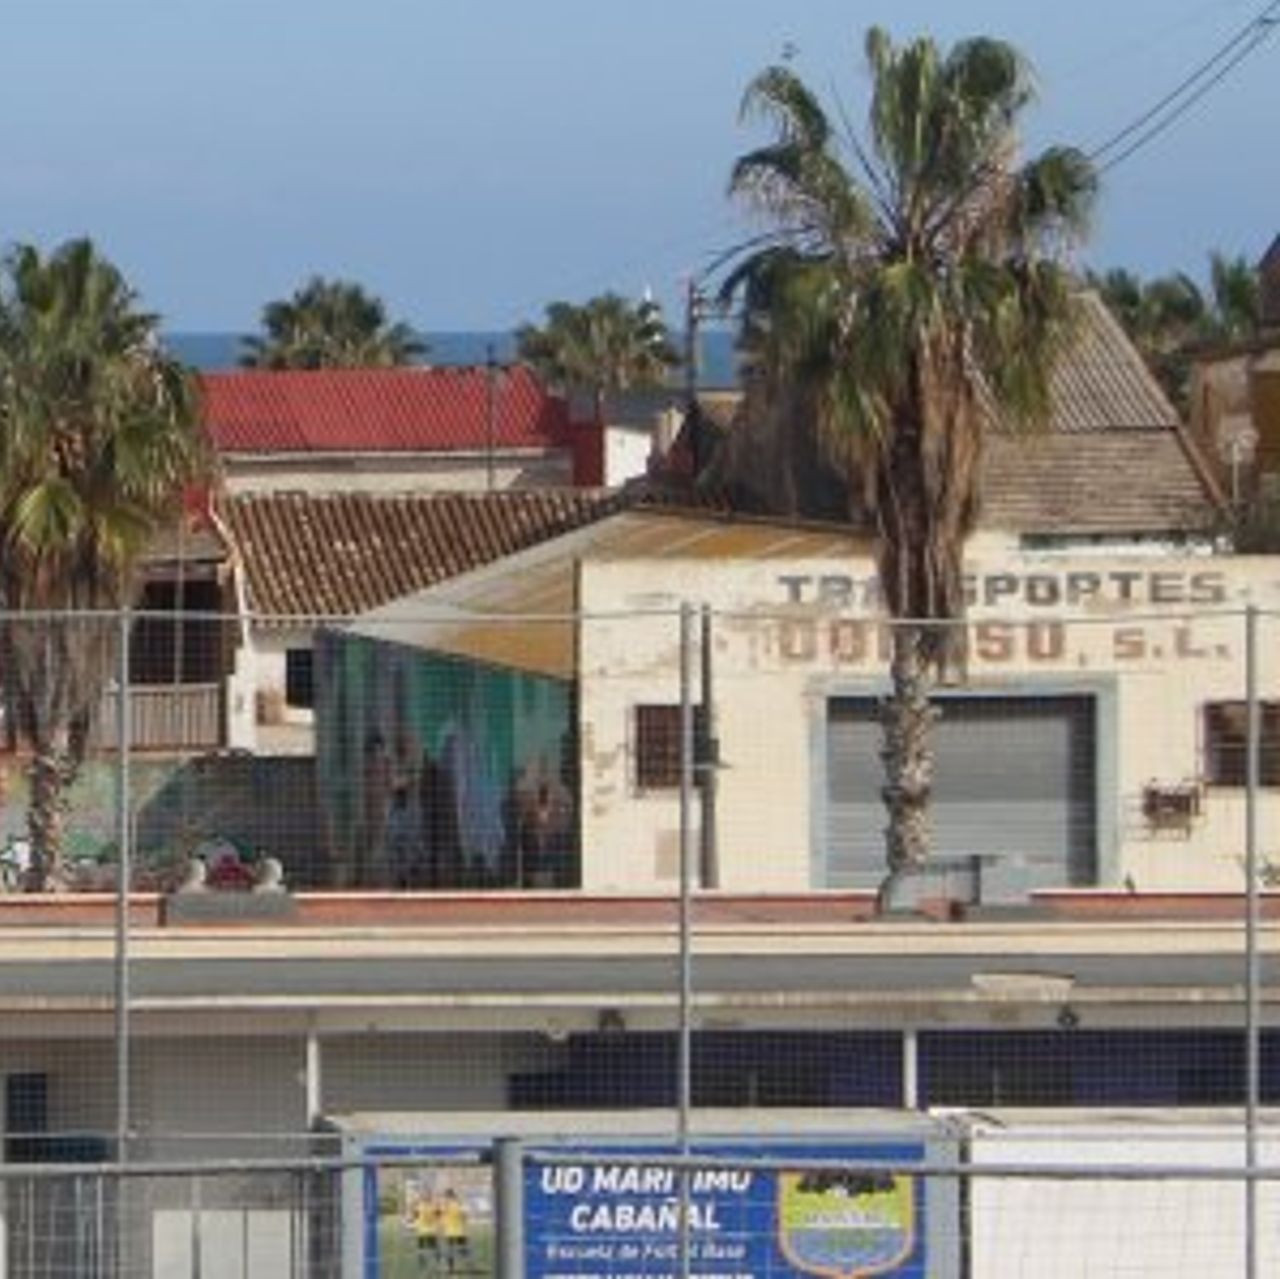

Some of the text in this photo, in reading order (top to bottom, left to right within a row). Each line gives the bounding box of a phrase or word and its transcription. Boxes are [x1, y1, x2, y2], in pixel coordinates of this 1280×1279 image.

[542, 1166, 751, 1194] UD MARIIMO
[570, 1197, 720, 1231] CABAÑAL
